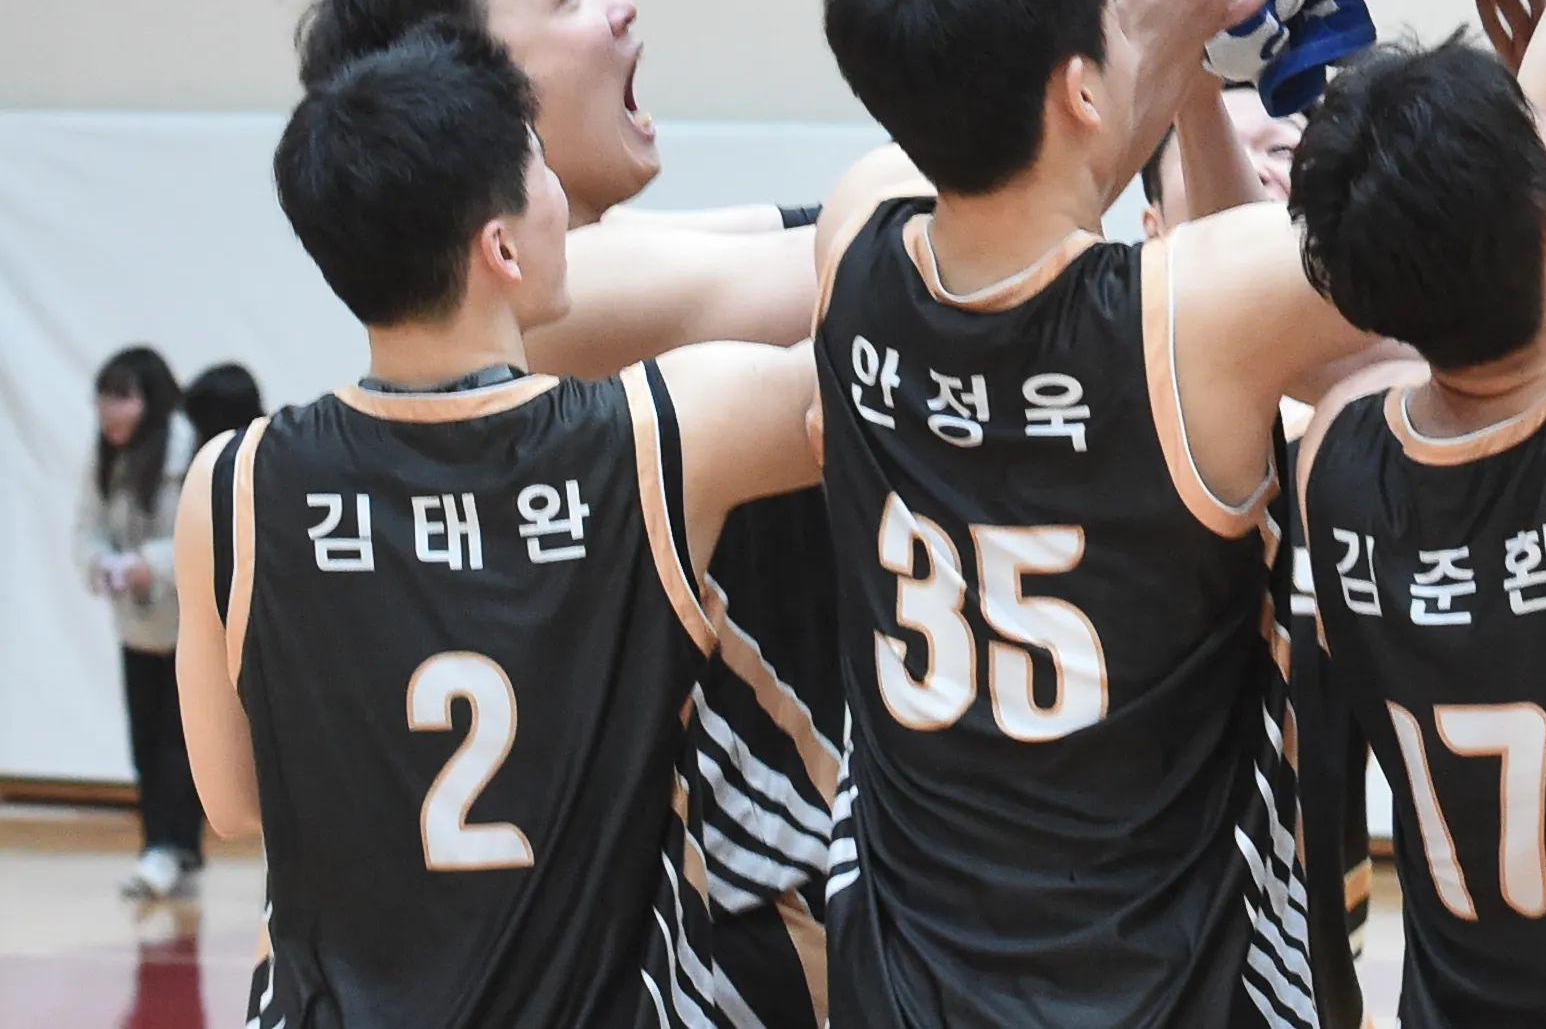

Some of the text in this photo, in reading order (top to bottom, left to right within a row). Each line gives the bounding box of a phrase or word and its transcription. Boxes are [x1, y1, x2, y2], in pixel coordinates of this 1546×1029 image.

[851, 334, 1091, 452] 안정욱
[306, 479, 590, 572] 김태완
[874, 491, 1109, 742] 35
[406, 650, 534, 870] 2
